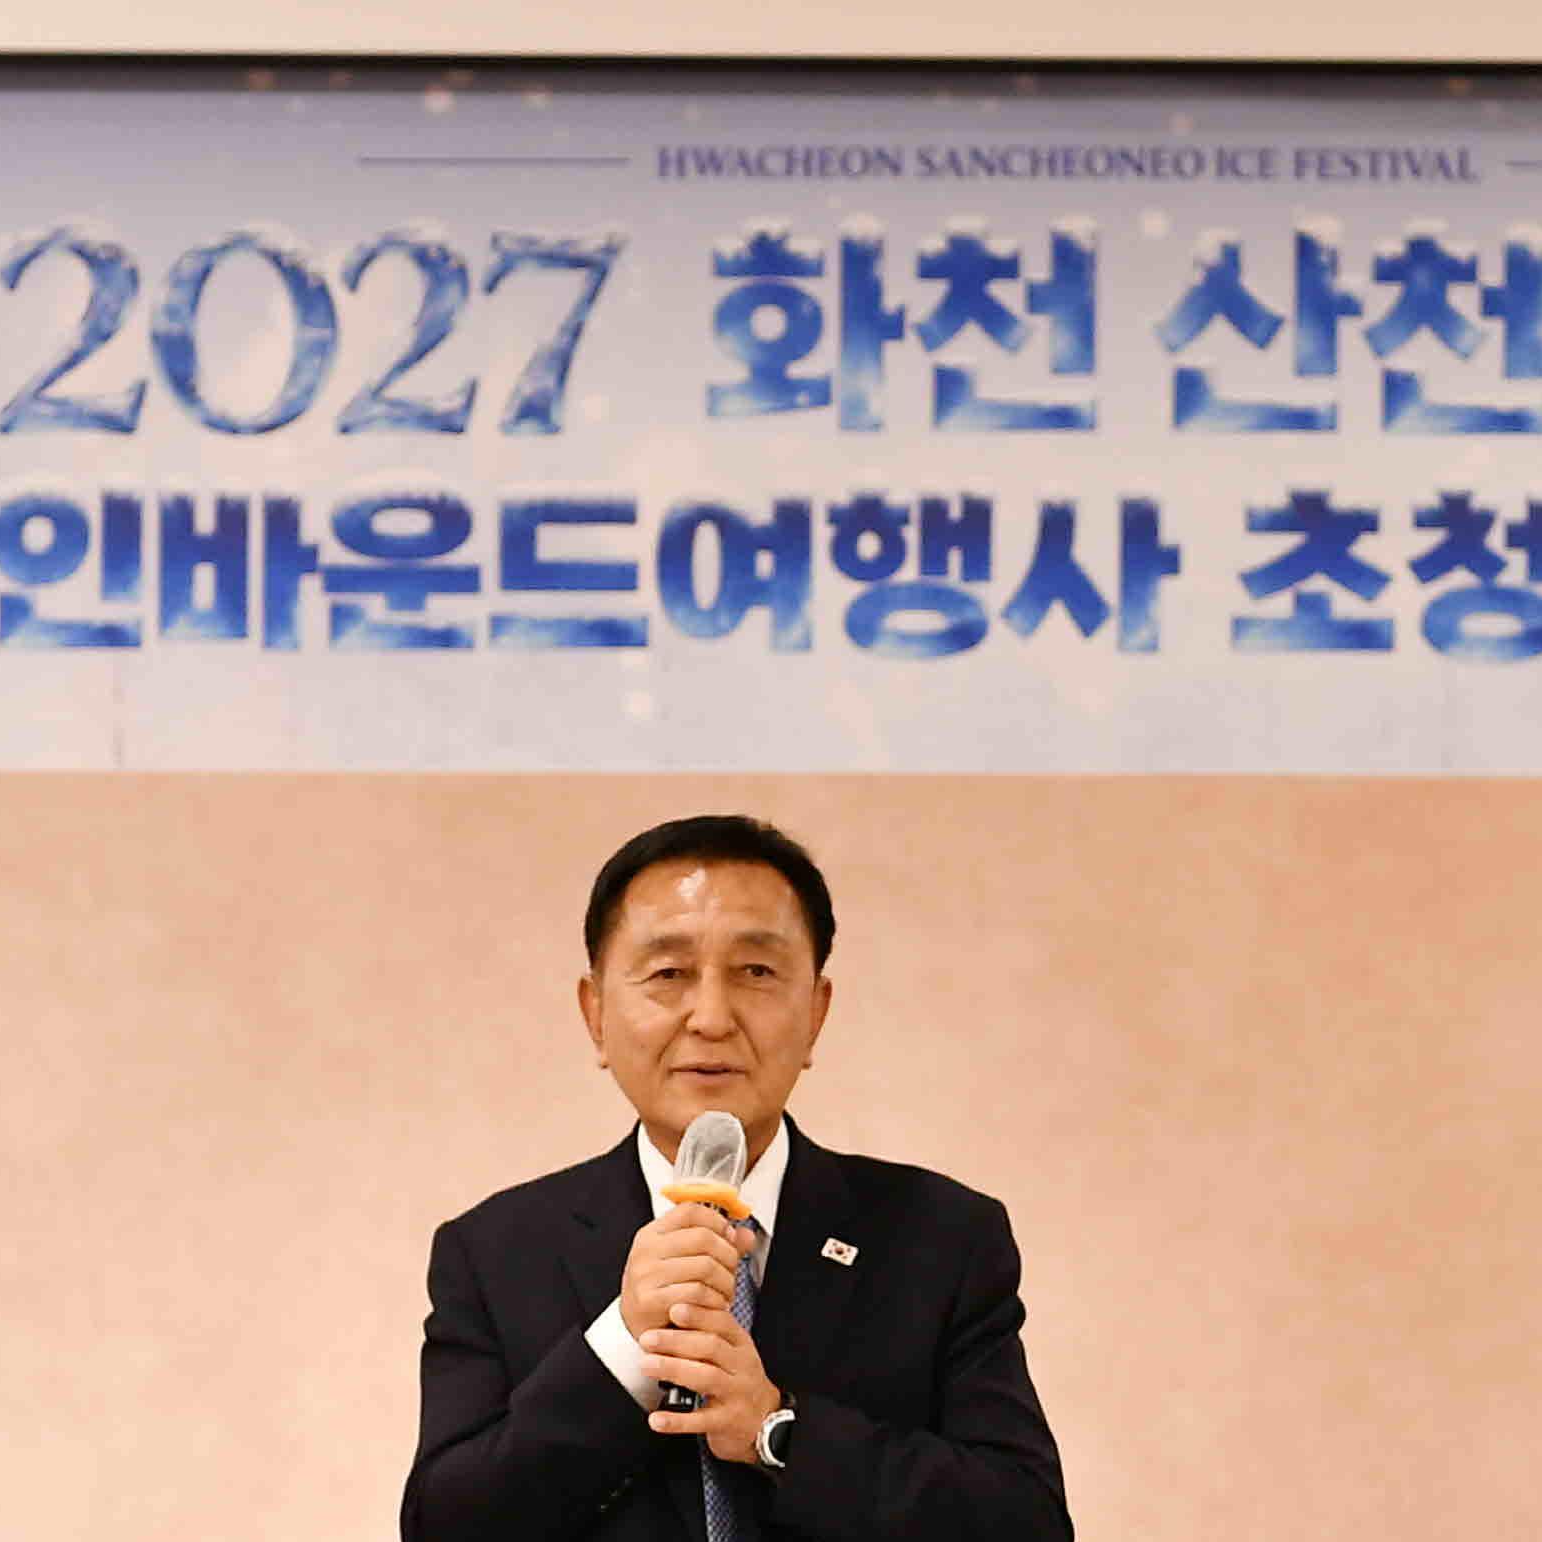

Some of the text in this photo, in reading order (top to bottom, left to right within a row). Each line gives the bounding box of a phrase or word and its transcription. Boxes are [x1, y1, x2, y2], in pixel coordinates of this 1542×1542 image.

[658, 145, 1481, 181] HWACHEON SANCHEONEO ICE FESTIVAL
[706, 228, 1098, 433] 화천
